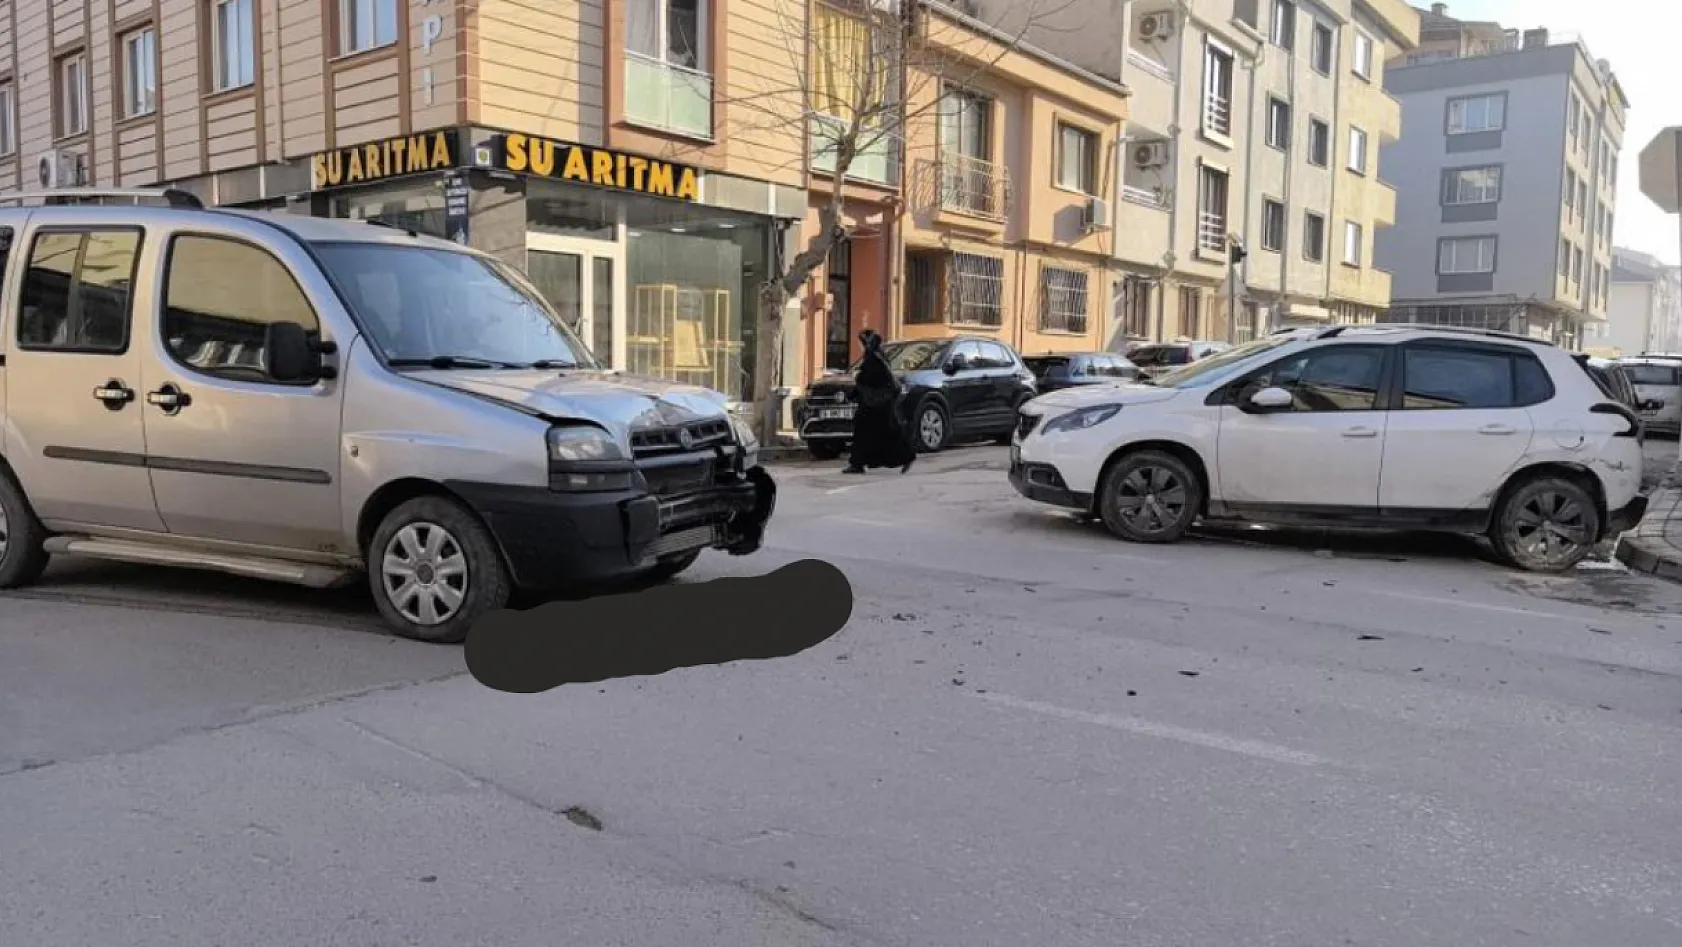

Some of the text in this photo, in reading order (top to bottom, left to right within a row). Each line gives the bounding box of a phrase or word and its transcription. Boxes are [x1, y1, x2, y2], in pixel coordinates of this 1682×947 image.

[313, 131, 451, 188] SU ARITMA
[506, 133, 699, 201] SU ARITMA
